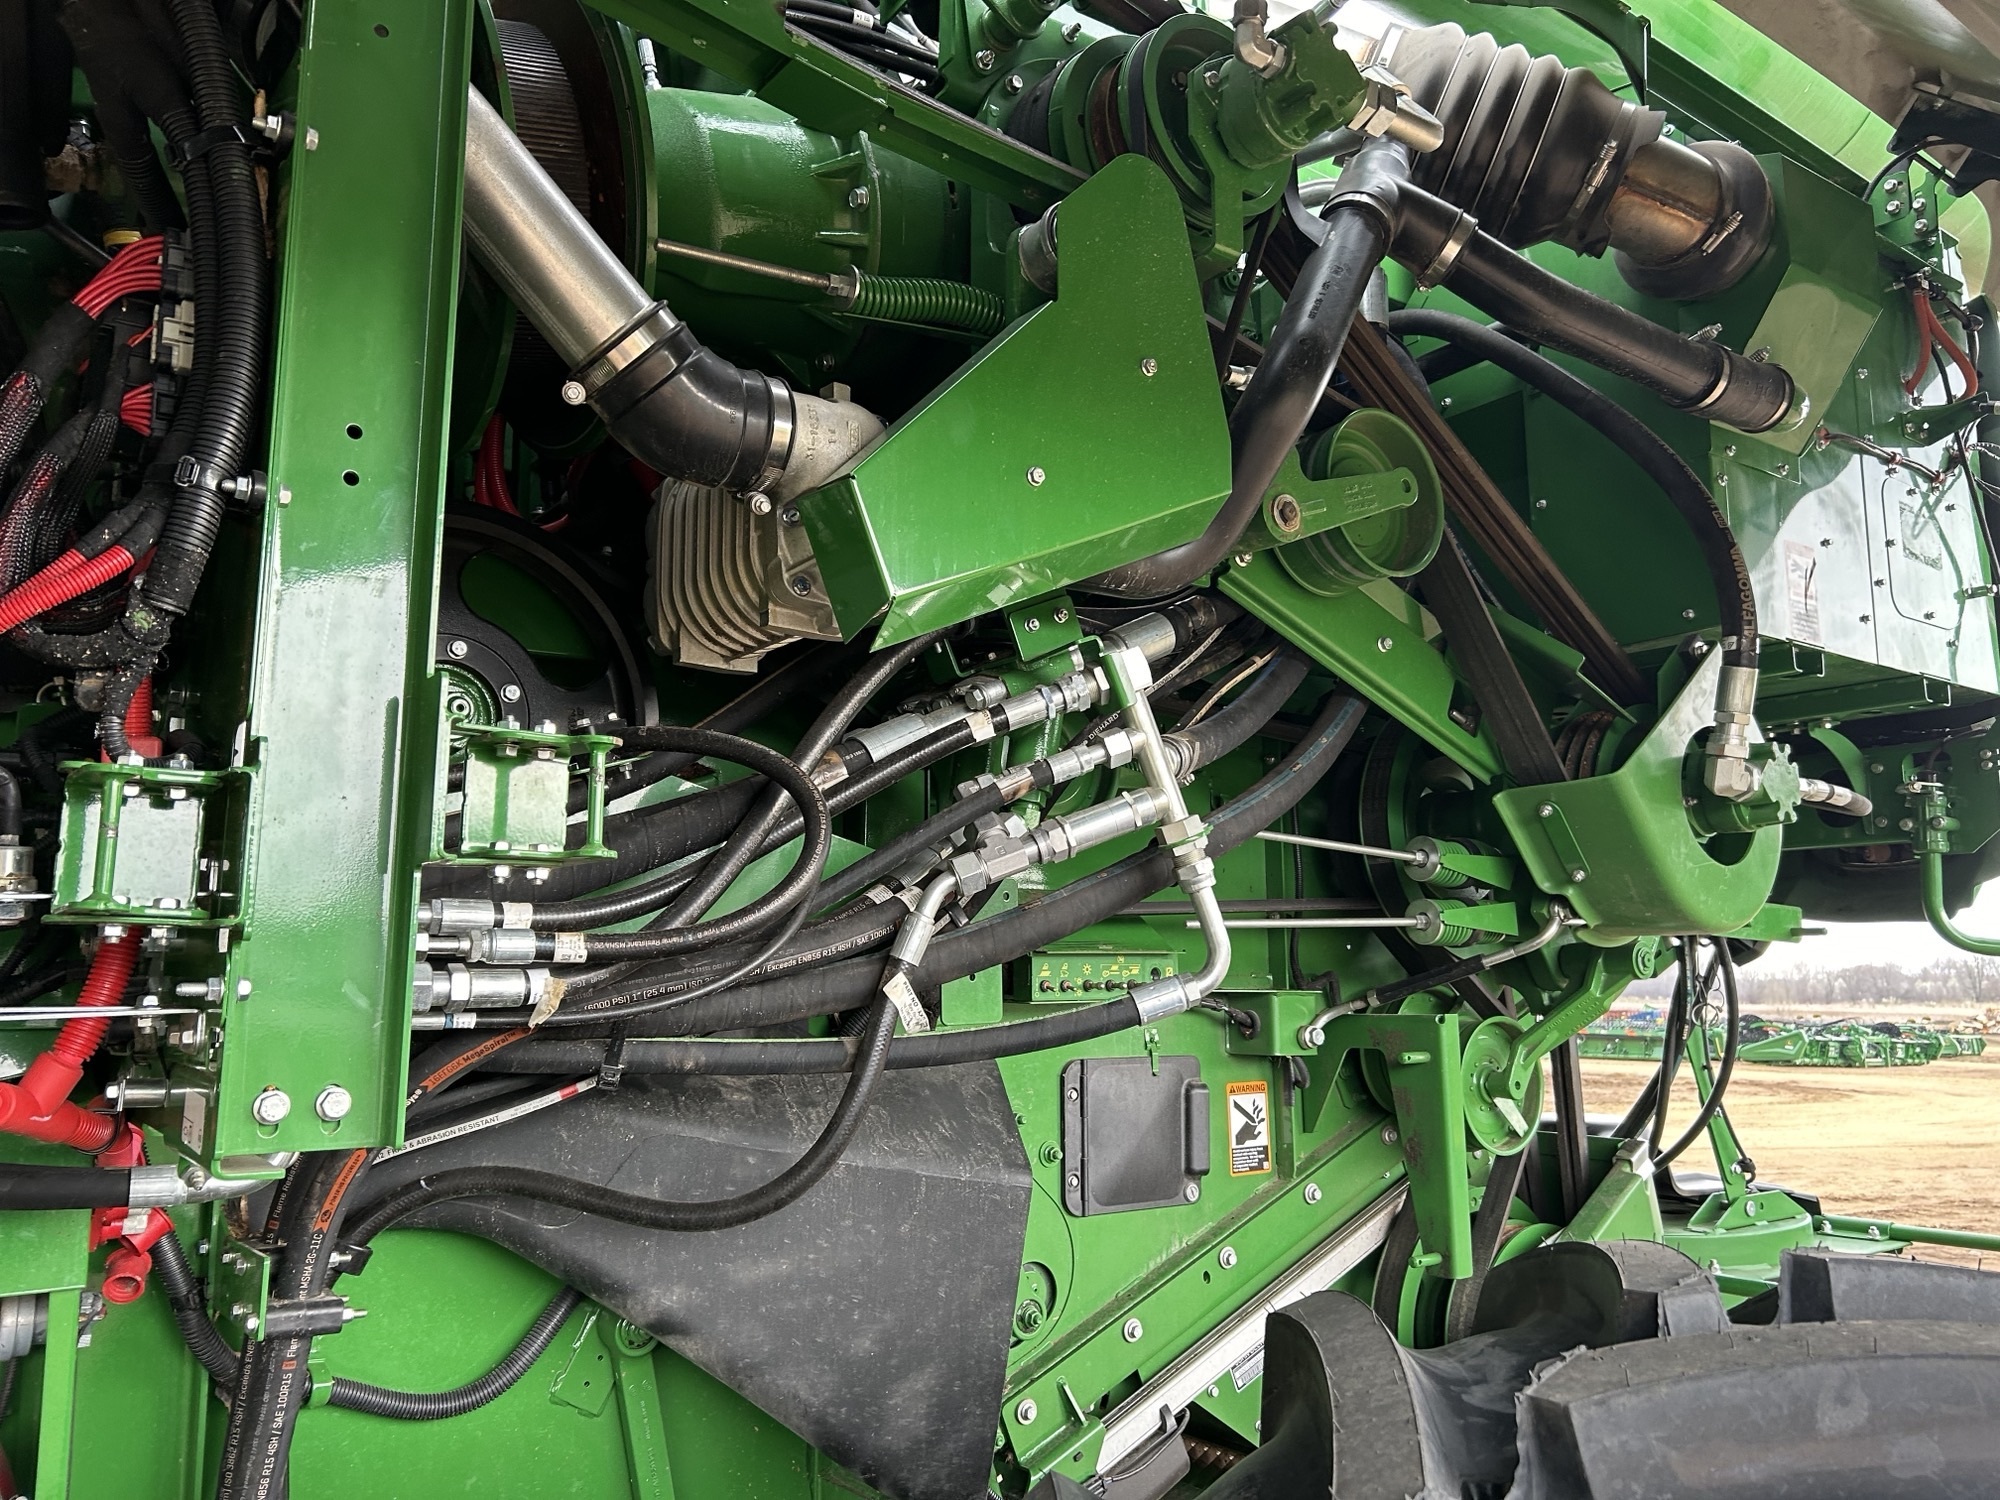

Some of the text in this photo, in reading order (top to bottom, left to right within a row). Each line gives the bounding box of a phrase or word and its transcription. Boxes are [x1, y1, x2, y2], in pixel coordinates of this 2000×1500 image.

[767, 960, 797, 972] Exceeds
[797, 952, 821, 965] EN856
[822, 947, 837, 957] R15
[837, 942, 852, 953] 4SH
[857, 935, 870, 946] SAE
[870, 925, 895, 942] 100R15
[667, 983, 688, 995] mm]
[1236, 1084, 1265, 1093] WARNING
[416, 1129, 457, 1146] ABRASION
[457, 1115, 500, 1133] RESISTANT
[273, 1192, 287, 1218] Flame
[305, 1233, 323, 1265] 2G-11C
[300, 1265, 314, 1289] MSHA
[286, 1338, 298, 1358] Flam
[239, 1362, 252, 1401] Exceeds
[276, 1373, 293, 1410] 100R15
[234, 1407, 244, 1427] 4SH
[273, 1409, 285, 1429] SAE
[231, 1427, 241, 1446] R15
[267, 1435, 280, 1456] 4SH
[225, 1446, 237, 1470] 3862
[262, 1457, 274, 1477] R15
[223, 1470, 233, 1489] ISO
